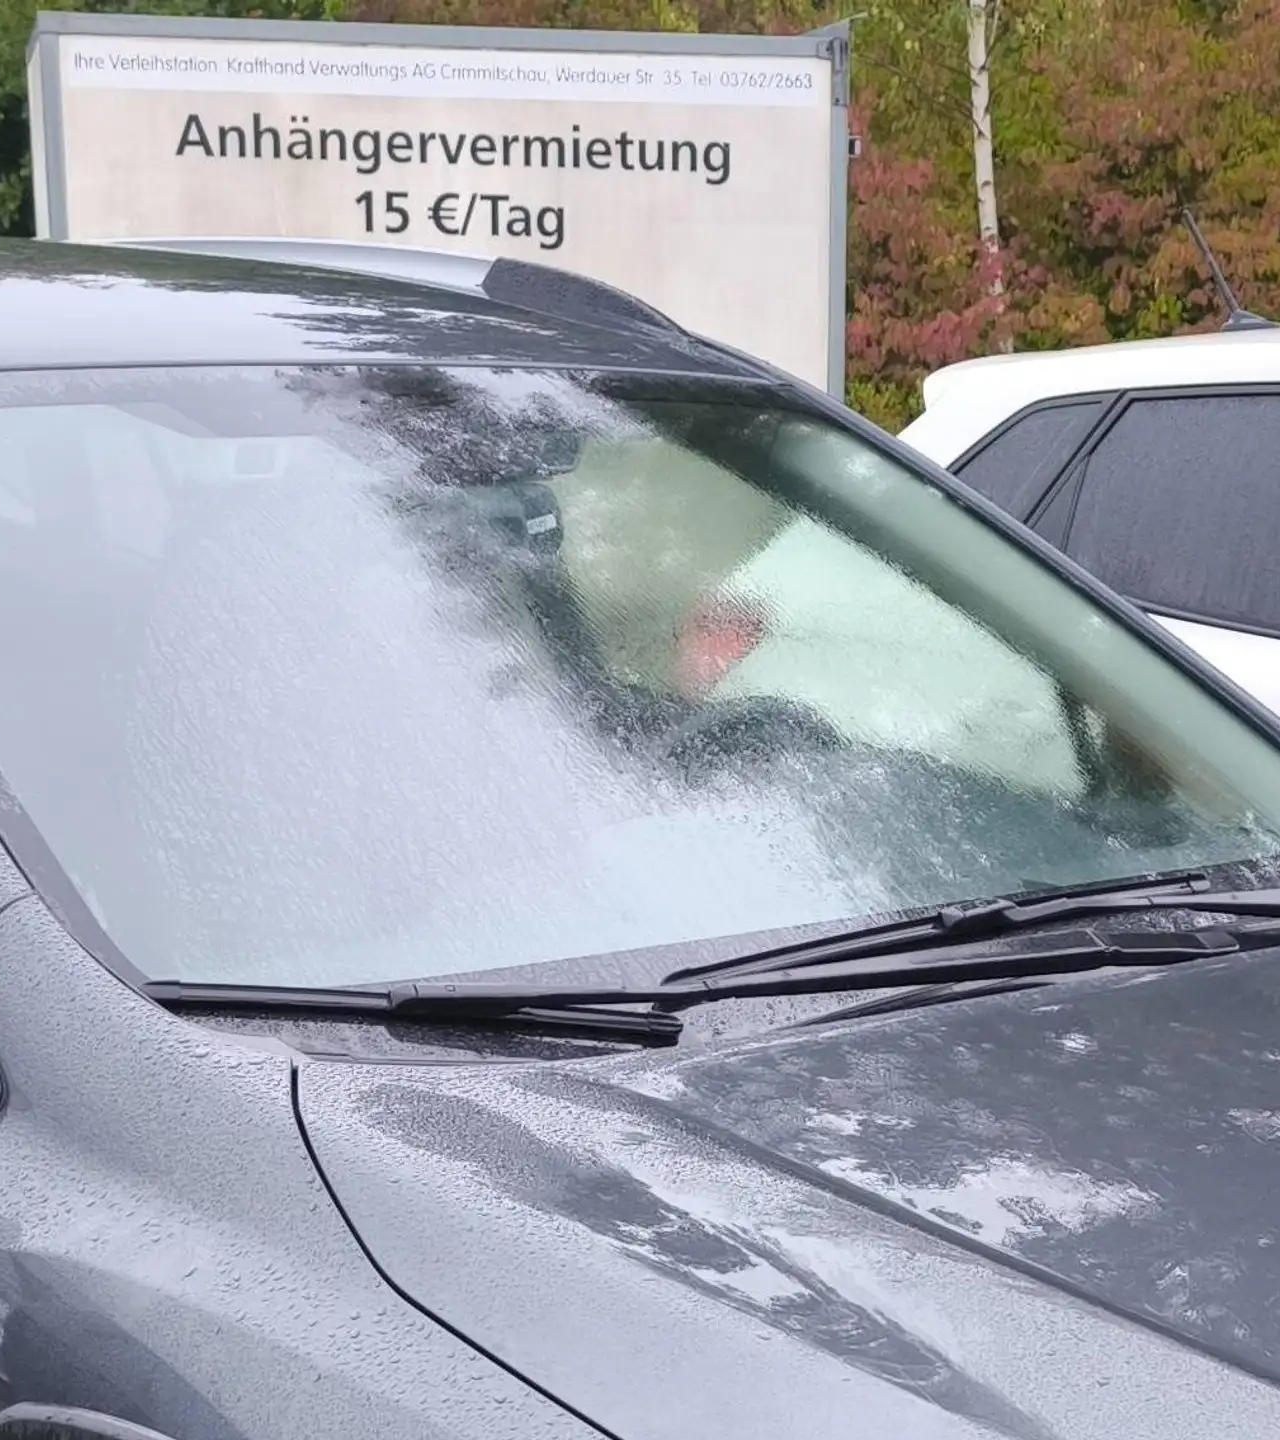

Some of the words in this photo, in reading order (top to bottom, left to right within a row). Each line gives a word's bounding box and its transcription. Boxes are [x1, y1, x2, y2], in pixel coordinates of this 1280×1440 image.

[73, 52, 105, 70] Ihre
[226, 56, 305, 76] Krafthand
[309, 60, 407, 82] Verwaltungs
[412, 63, 436, 80] AG
[555, 63, 630, 84] Werdauer
[720, 70, 813, 90] 03762/2663
[174, 112, 733, 185] Anhängervermietung
[354, 190, 410, 234] 15
[427, 193, 566, 250] €/Tag
